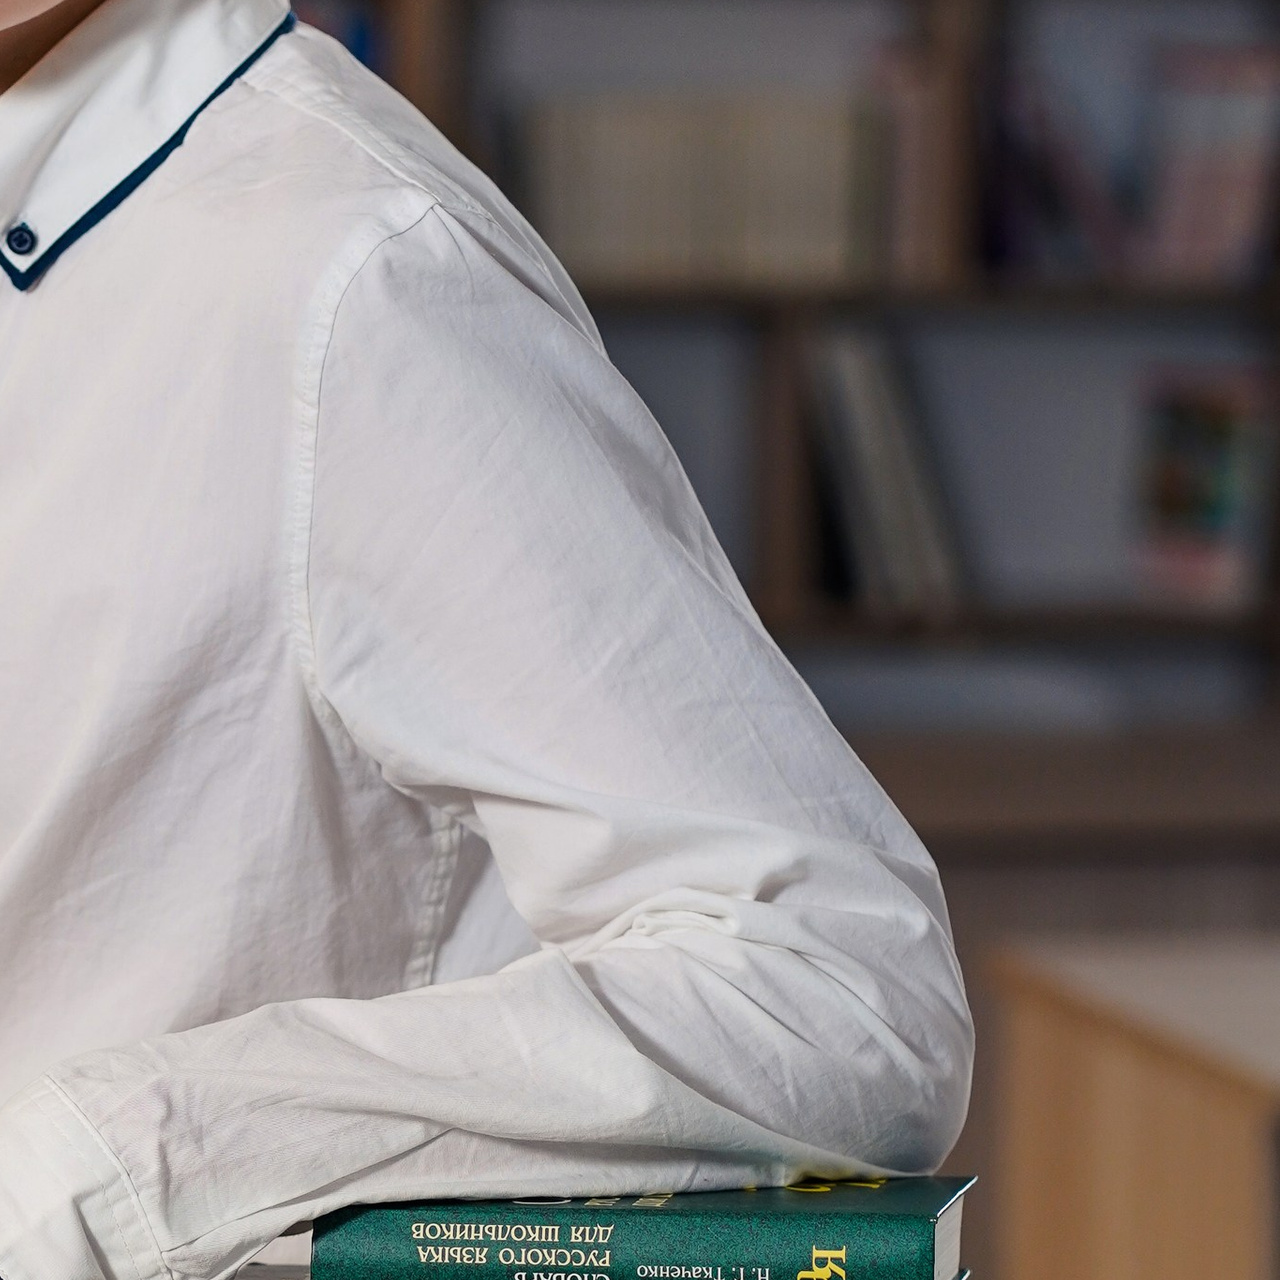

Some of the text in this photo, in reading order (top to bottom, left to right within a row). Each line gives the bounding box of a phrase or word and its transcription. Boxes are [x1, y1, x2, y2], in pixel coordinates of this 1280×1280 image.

[411, 1223, 615, 1242] ДЛЯ ШКОЛЬНИКОВ
[417, 1245, 611, 1266] РУССКОГО ЯЗЫКА
